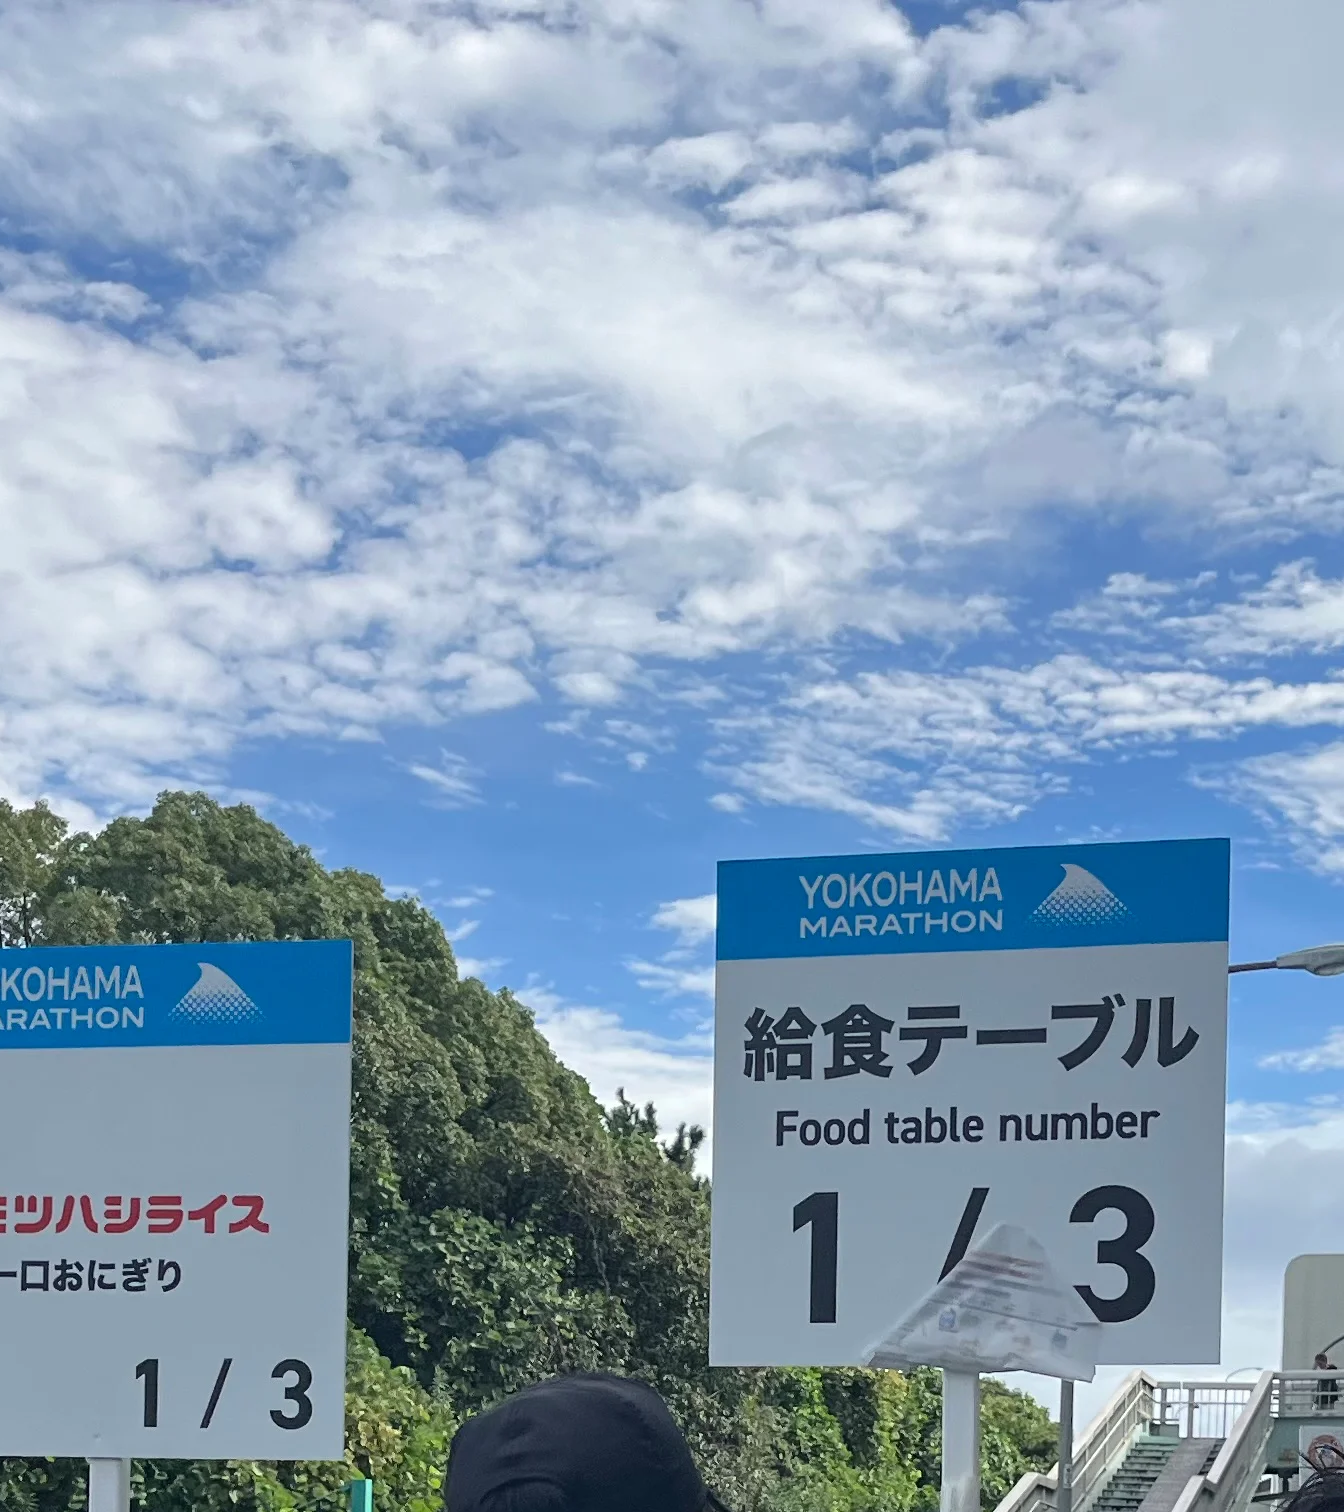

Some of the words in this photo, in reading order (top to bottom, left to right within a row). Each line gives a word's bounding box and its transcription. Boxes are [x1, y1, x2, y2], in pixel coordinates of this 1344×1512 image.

[799, 867, 1003, 910] YOKOHAMA
[799, 909, 1003, 939] MARATHON
[743, 993, 1200, 1082] 給食テーブル
[776, 1108, 871, 1147] Food
[884, 1105, 984, 1145] table
[999, 1102, 1160, 1143] number
[792, 1191, 839, 1324] 1
[1069, 1185, 1156, 1323] 3
[135, 1358, 159, 1428] 1
[269, 1359, 313, 1430] 3
